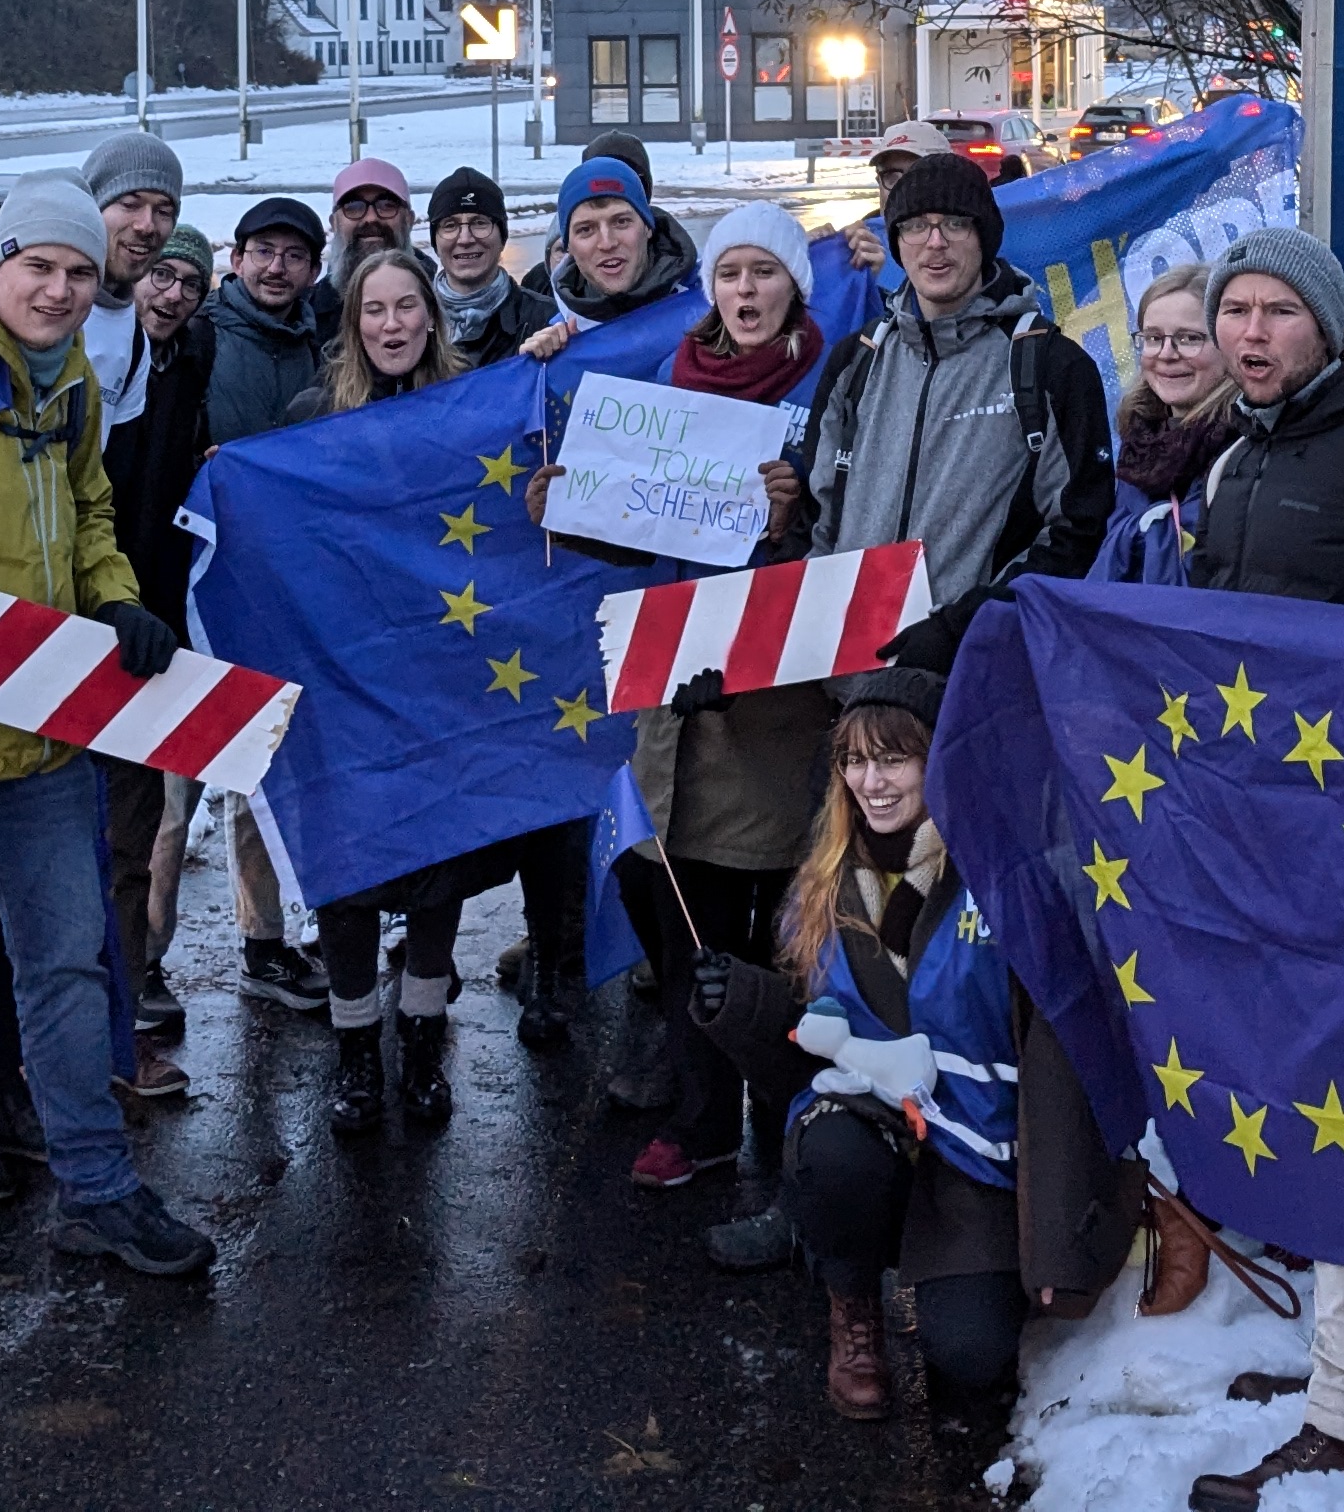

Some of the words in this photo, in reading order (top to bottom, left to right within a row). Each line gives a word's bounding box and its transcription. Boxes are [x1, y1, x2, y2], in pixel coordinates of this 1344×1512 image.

[583, 396, 699, 443] #DON'T
[648, 446, 747, 496] TOUCH
[567, 468, 609, 501] MY
[626, 478, 766, 536] SCHENGEN
